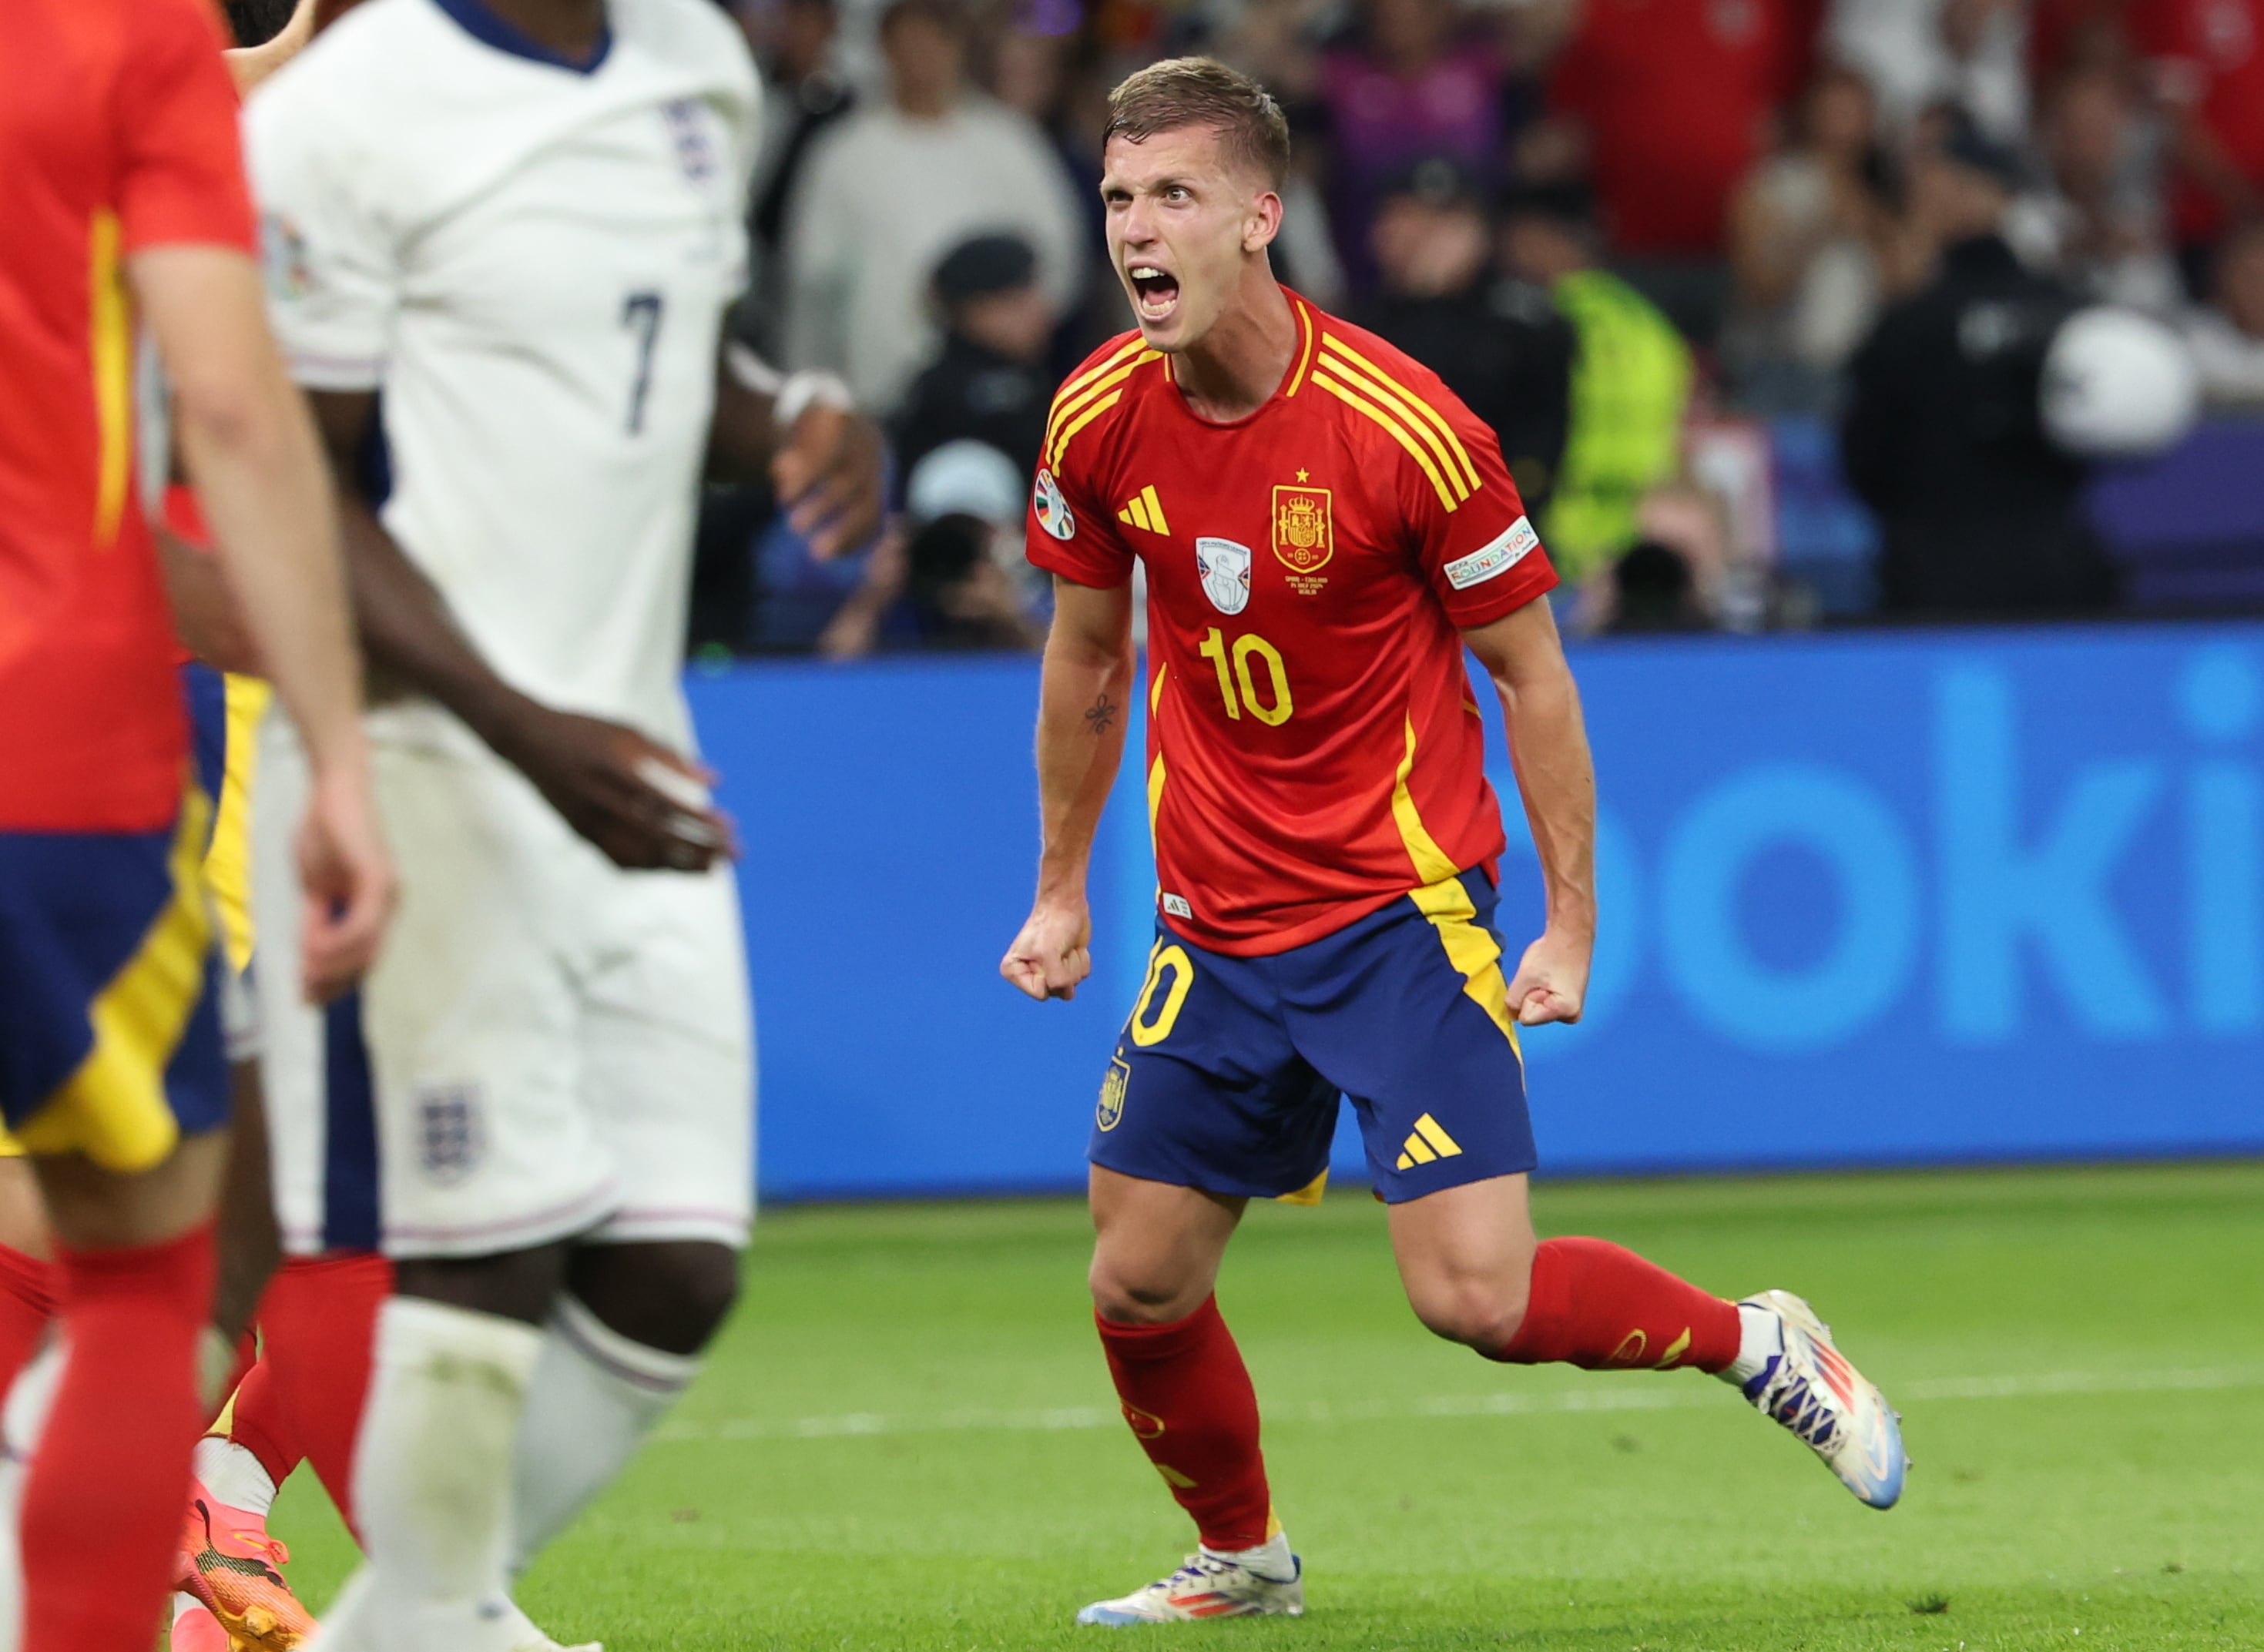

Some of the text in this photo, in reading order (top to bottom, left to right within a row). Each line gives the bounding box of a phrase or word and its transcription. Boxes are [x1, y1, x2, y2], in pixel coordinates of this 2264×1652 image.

[620, 292, 662, 433] 7
[1451, 527, 1531, 581] FOUNDATION
[1199, 626, 1293, 726] 10
